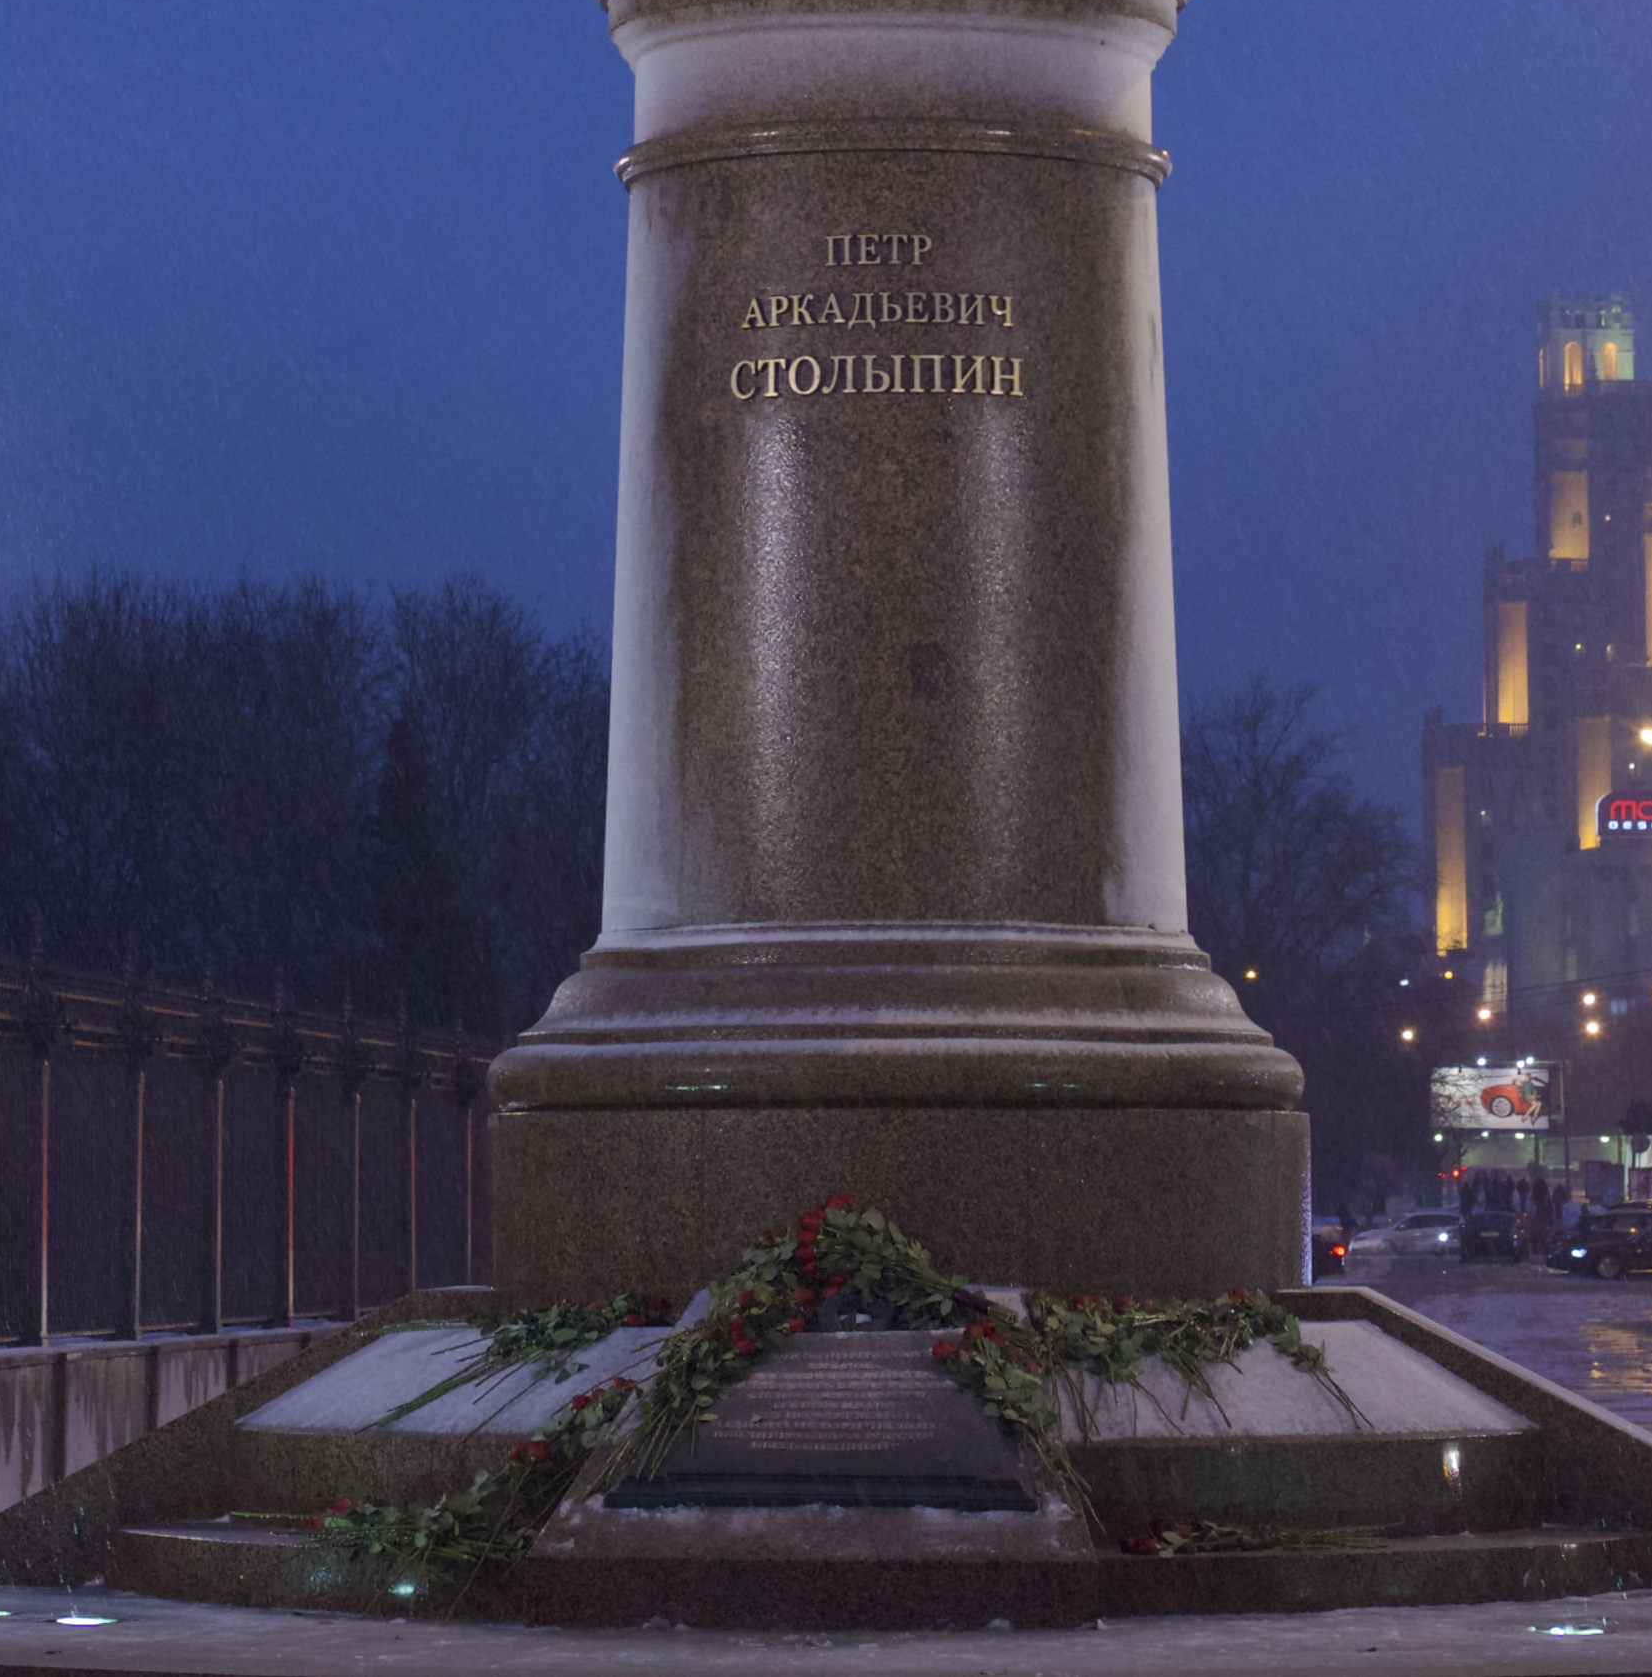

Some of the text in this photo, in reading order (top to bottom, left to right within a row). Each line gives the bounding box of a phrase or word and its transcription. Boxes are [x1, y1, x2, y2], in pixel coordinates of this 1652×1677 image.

[824, 233, 933, 267] ПЕТР
[740, 292, 1015, 330] АРКАДЬЕВИЧ
[730, 354, 1025, 400] СТОЛЫПИН
